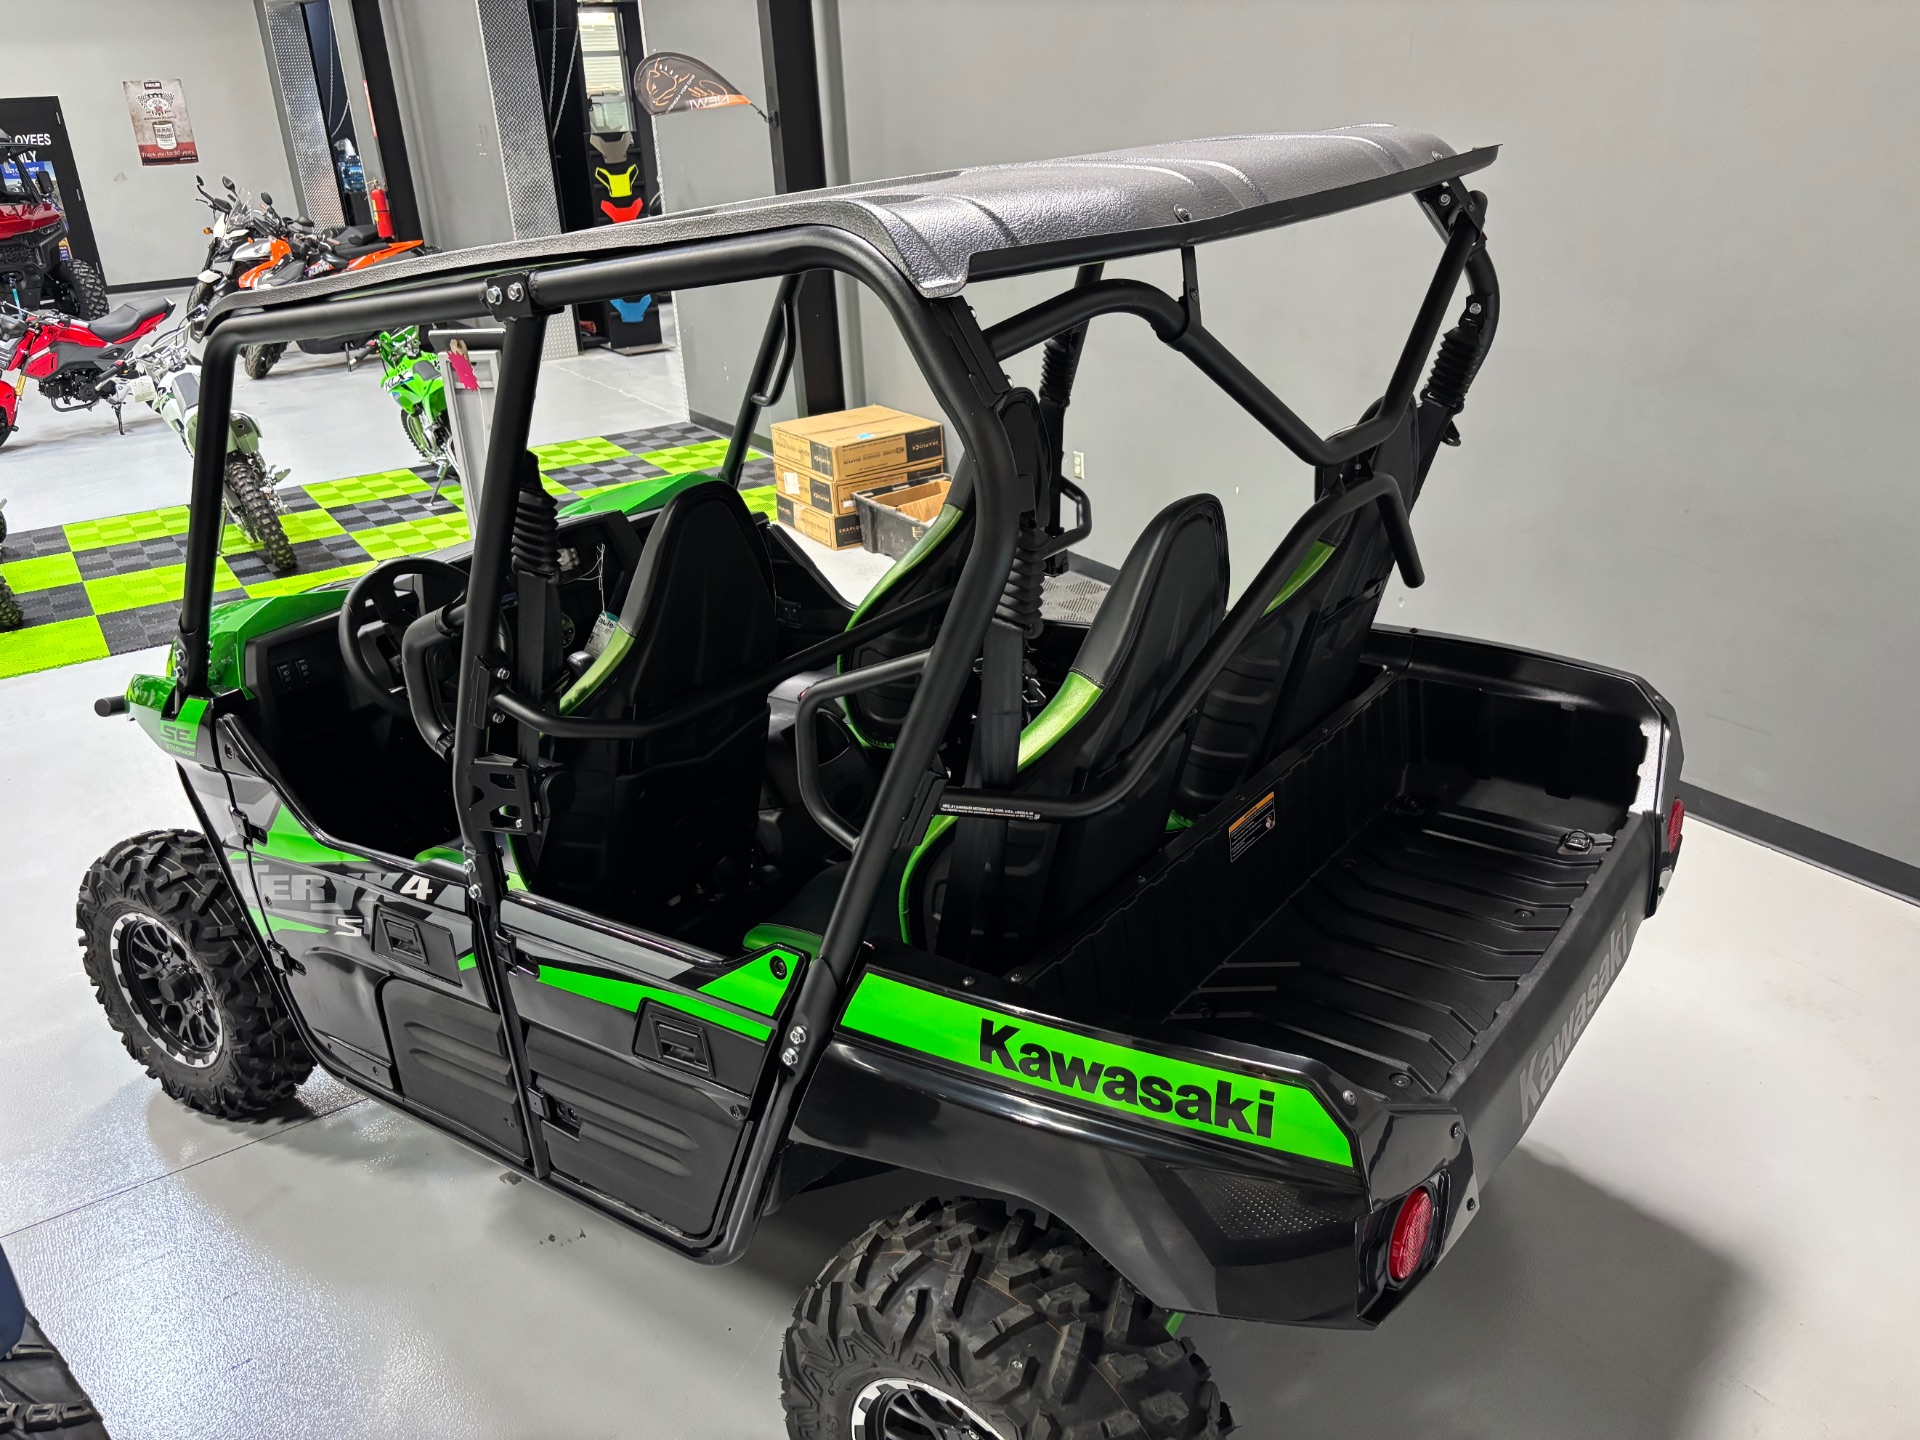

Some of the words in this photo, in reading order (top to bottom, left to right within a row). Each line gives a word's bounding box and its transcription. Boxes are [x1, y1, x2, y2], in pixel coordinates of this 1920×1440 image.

[9, 133, 52, 146] OYEES
[838, 525, 862, 534] SNAPLO
[1519, 911, 1628, 1126] Kawasaki
[979, 1017, 1276, 1140] Kawasaki
